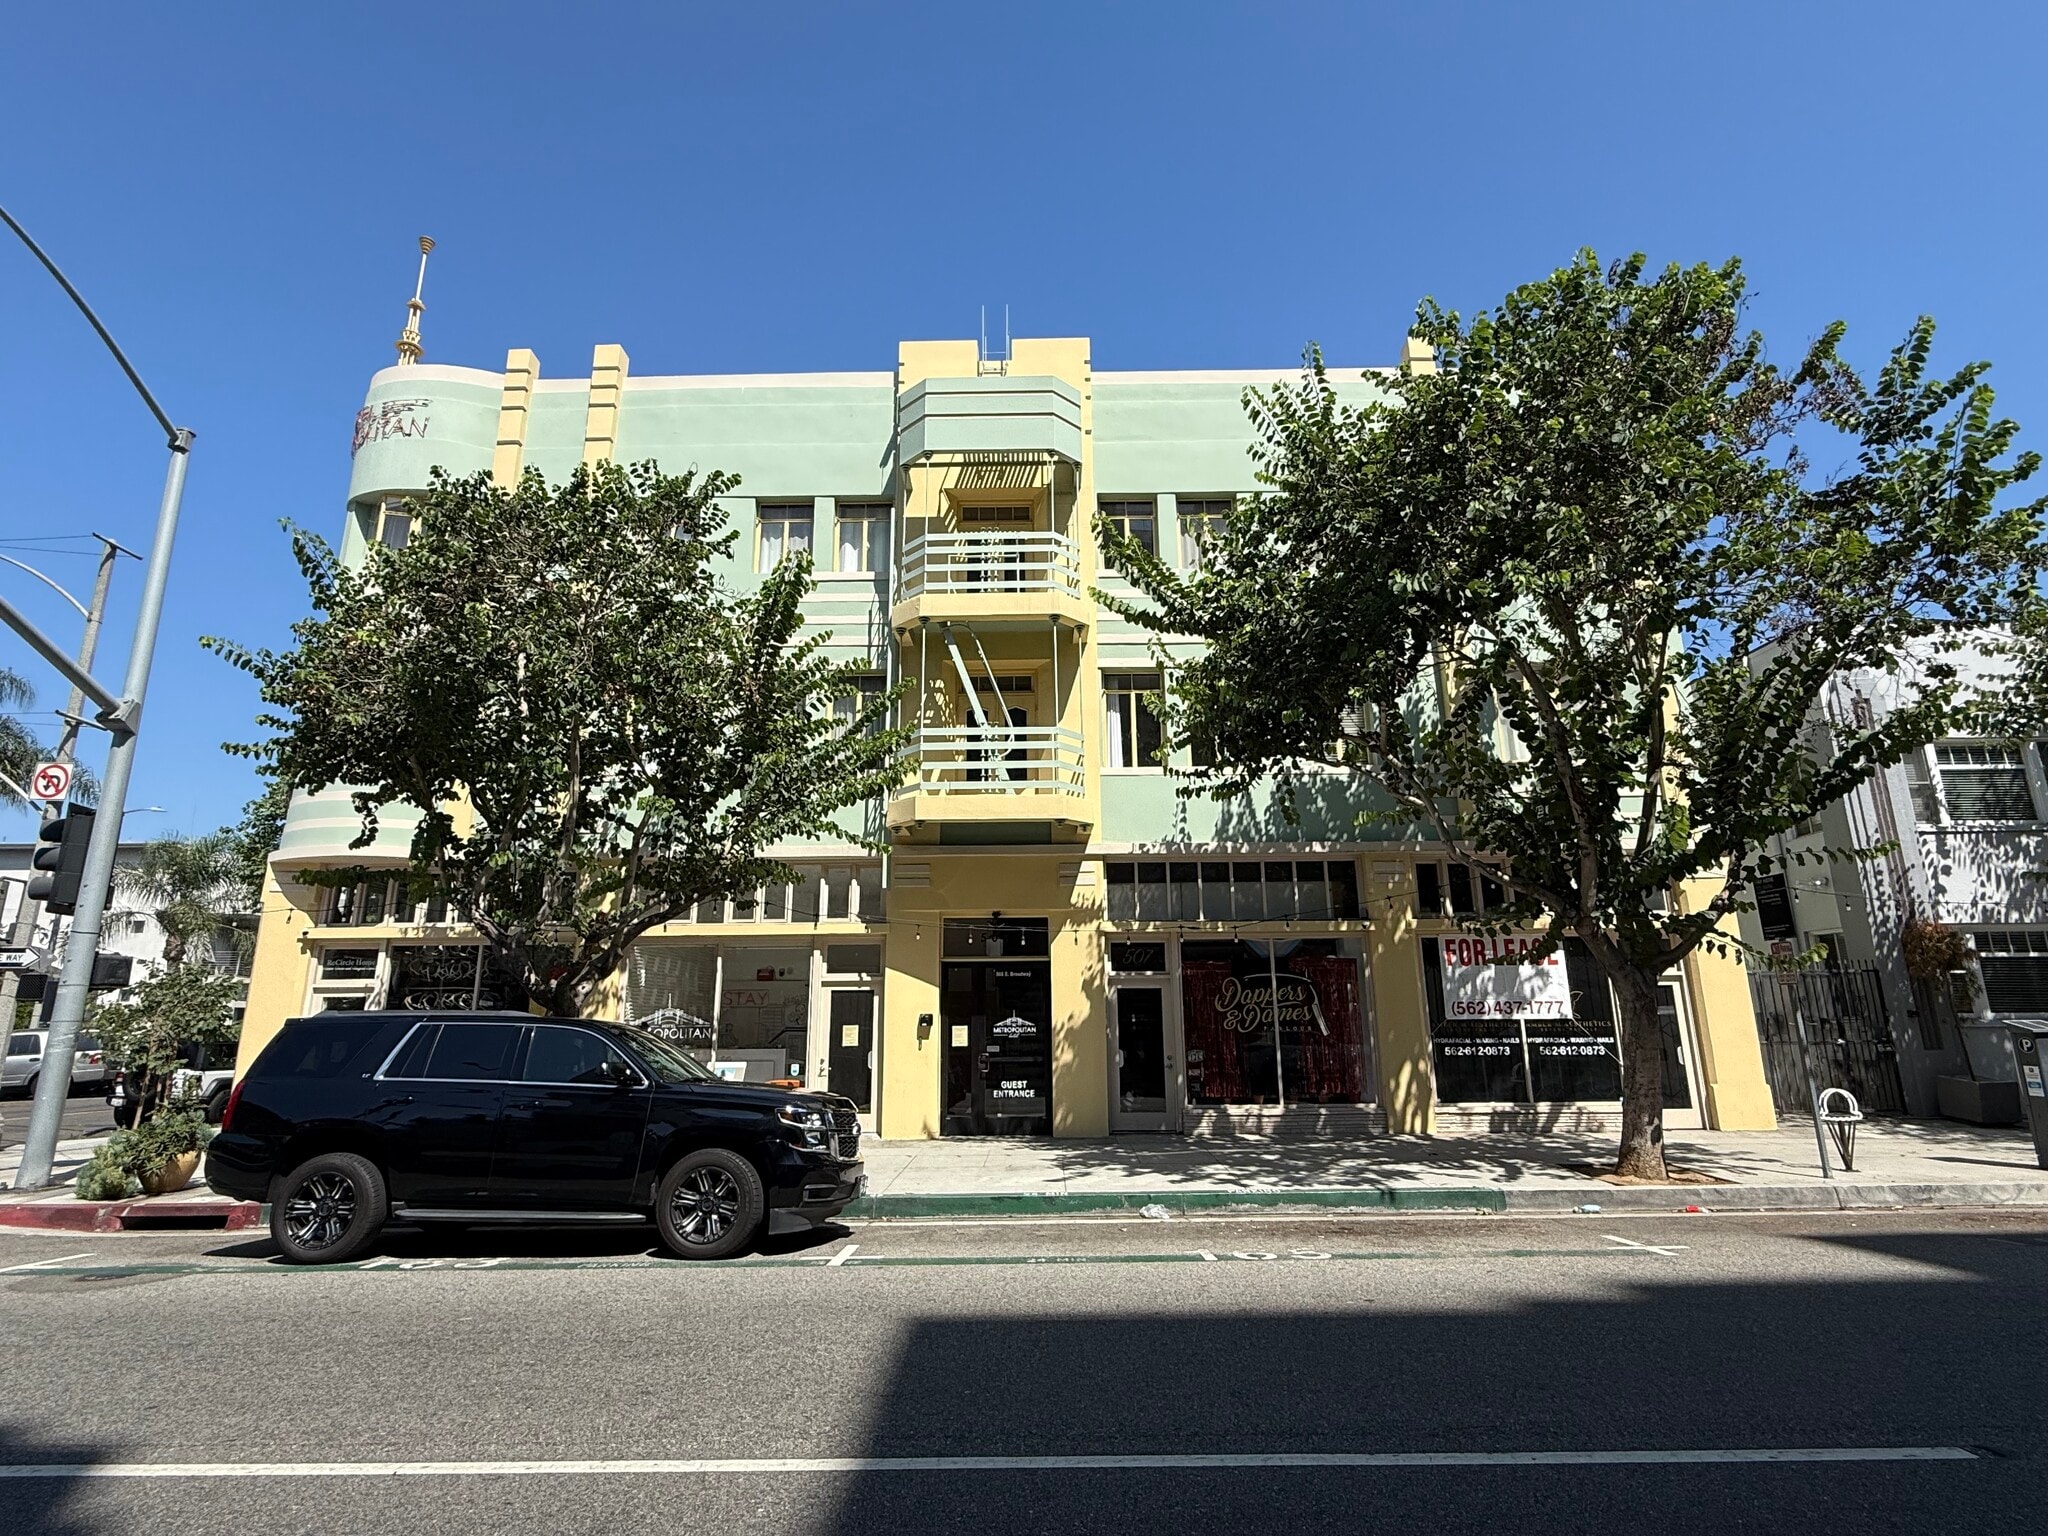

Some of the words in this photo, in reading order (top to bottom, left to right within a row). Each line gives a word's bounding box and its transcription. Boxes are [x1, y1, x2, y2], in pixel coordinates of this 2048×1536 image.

[1122, 948, 1154, 964] 507
[1444, 938, 1487, 966] FOR
[1491, 938, 1559, 966] LEA
[723, 991, 768, 1005] STAY
[1215, 977, 1307, 1012] Dappers
[1451, 1000, 1491, 1016] (562)
[1494, 1000, 1563, 1015] 437-1777
[1237, 1004, 1312, 1032] Dames
[647, 1027, 712, 1040] OPOLITAN
[1444, 1046, 1511, 1056] 562-612-0873
[1539, 1045, 1606, 1056] 562-612-0873
[1000, 1080, 1028, 1089] GUEST
[993, 1089, 1036, 1098] ENTRANCE
[1184, 1245, 1332, 1261] 165
